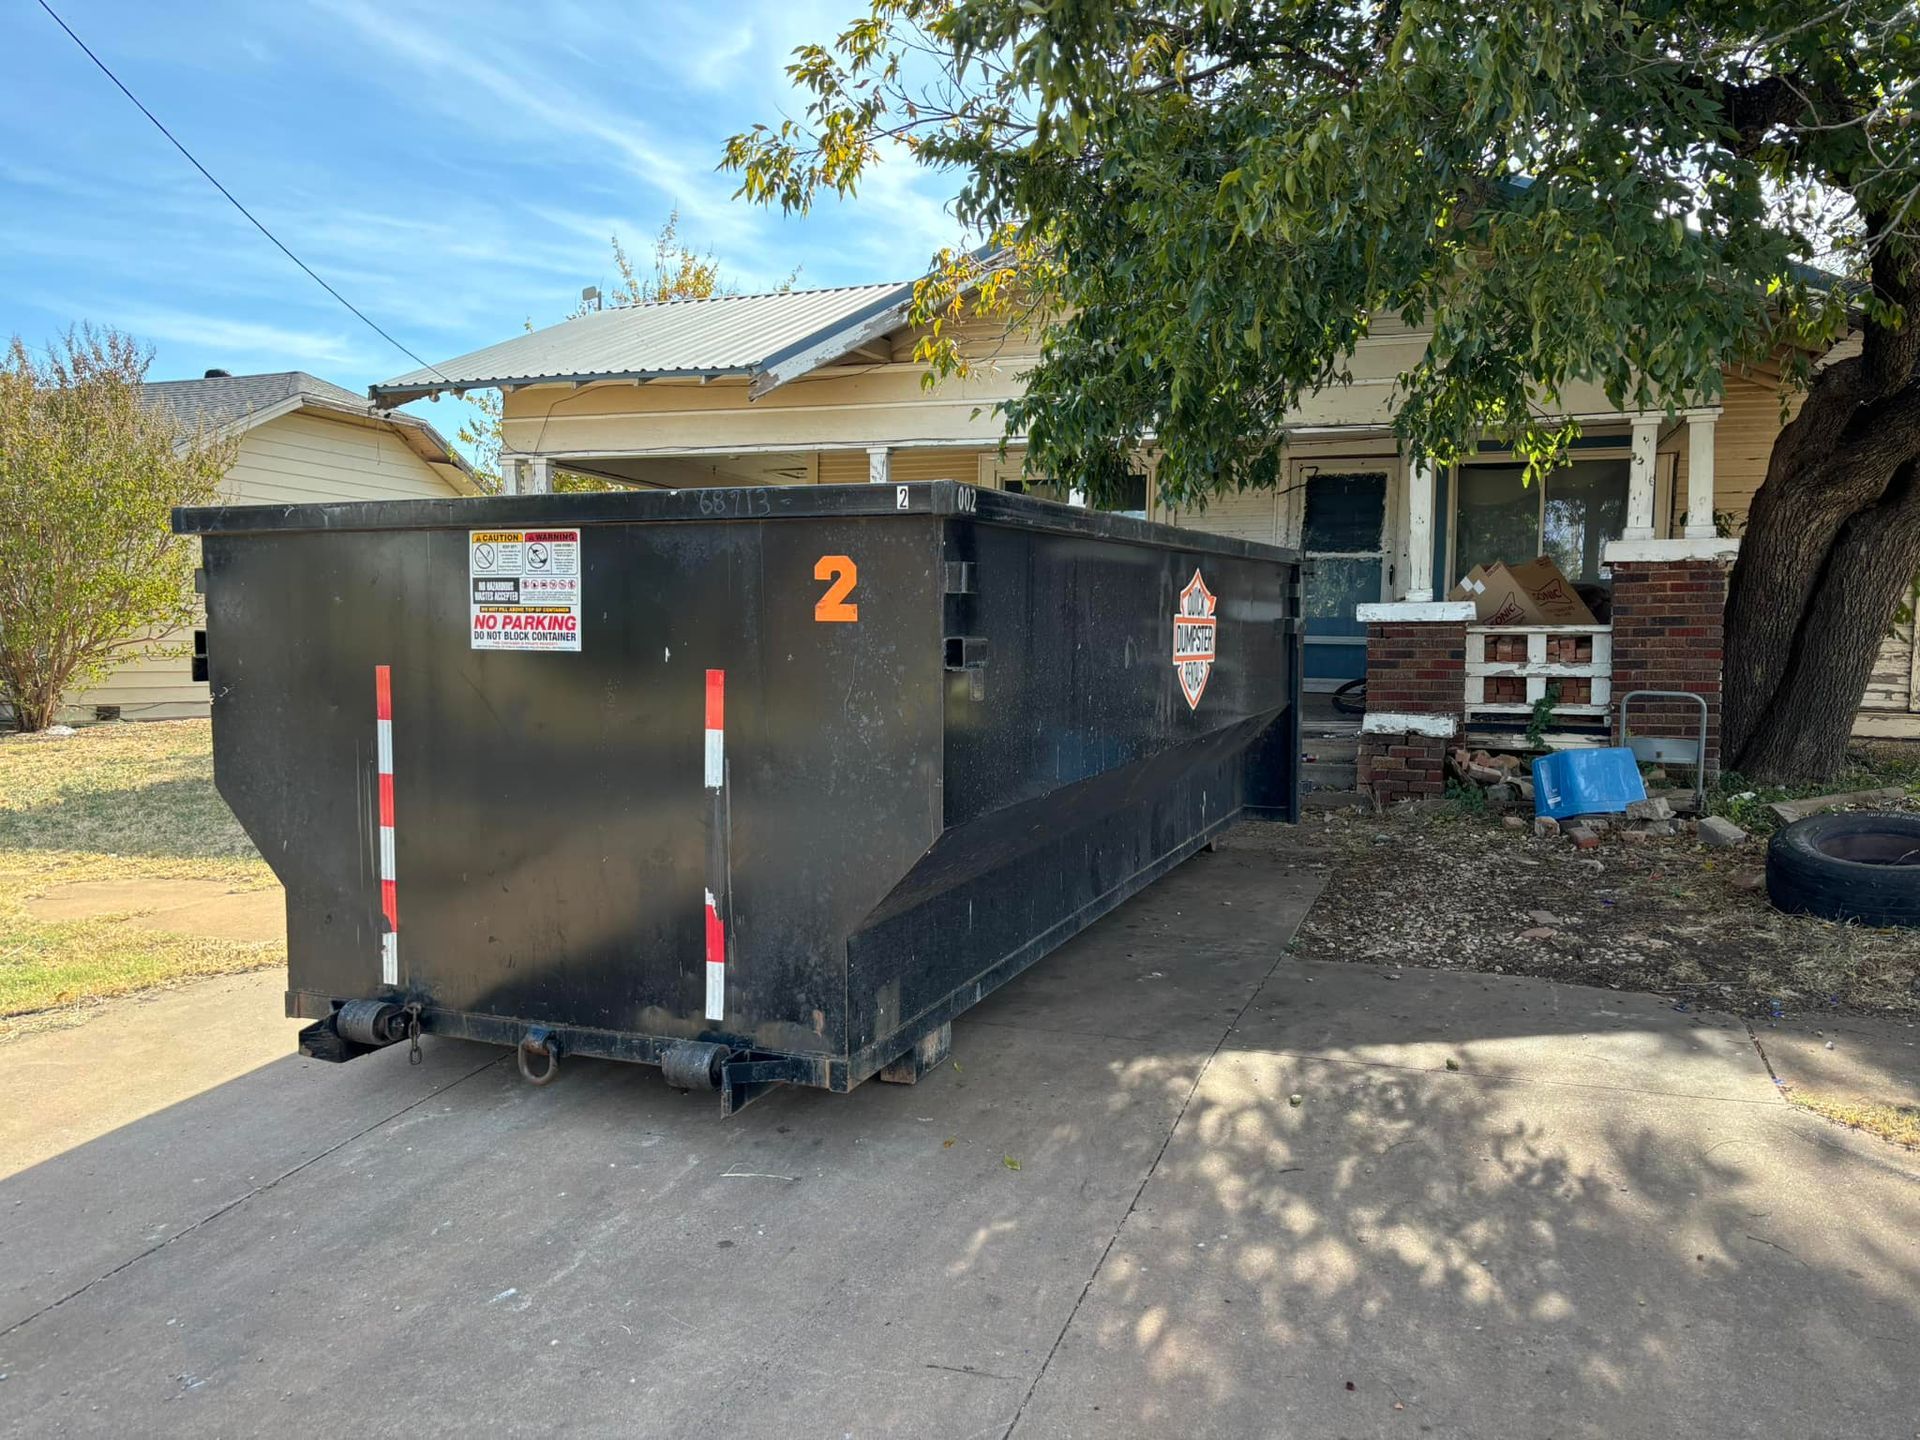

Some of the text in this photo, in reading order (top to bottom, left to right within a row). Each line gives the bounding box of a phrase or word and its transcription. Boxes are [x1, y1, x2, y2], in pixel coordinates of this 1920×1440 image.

[899, 489, 908, 508] 2
[957, 486, 977, 512] 002
[535, 533, 575, 541] WARNING
[814, 555, 858, 622] 2
[474, 614, 577, 631] NO PARKING
[474, 630, 577, 642] DO NOT BLOCK CONTAINER
[1177, 624, 1214, 653] DUMPSTER
